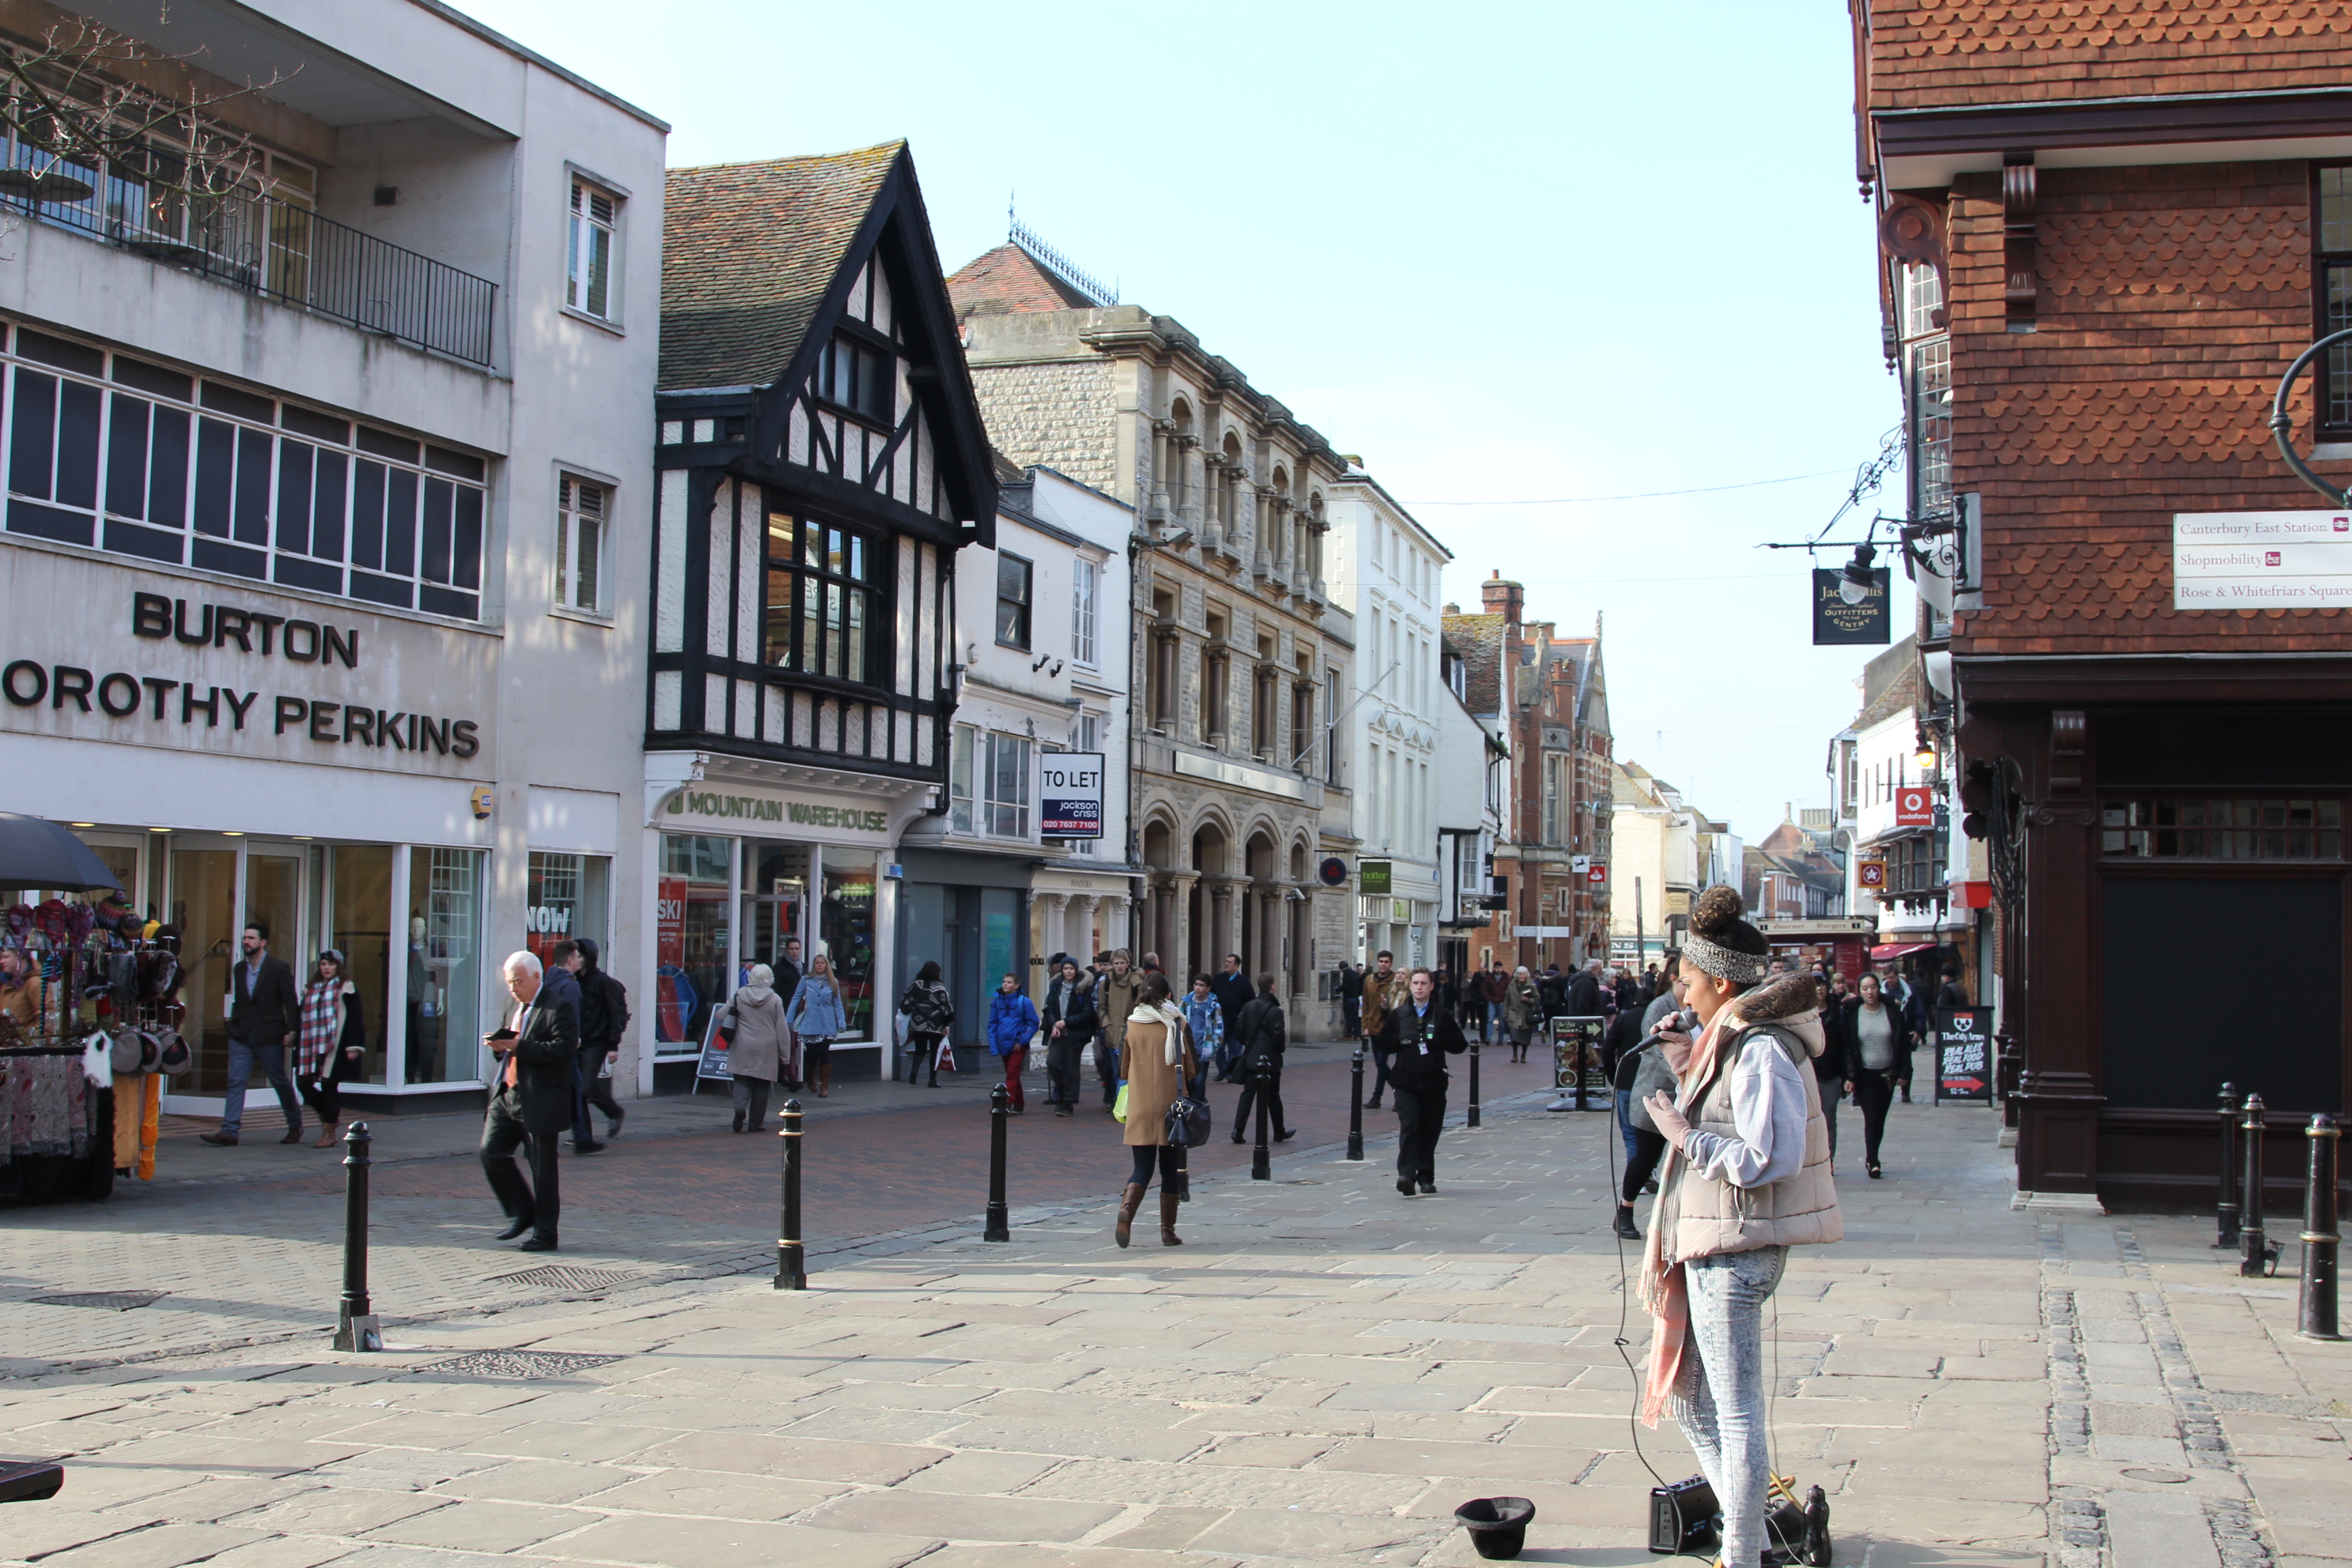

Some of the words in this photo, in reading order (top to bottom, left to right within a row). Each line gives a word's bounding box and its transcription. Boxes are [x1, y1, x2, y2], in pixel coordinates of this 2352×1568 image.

[2180, 523, 2251, 538] Canterbury
[2255, 523, 2280, 533] East
[2284, 522, 2328, 533] Station
[2180, 553, 2263, 569] Shopmobility
[1820, 586, 1840, 601] Jac
[2180, 587, 2212, 598] Rose
[2216, 587, 2226, 597] &
[2232, 585, 2305, 597] Whitefriars
[133, 591, 359, 668] BURTON
[1833, 617, 1870, 628] GENTRY
[2, 658, 259, 730] OROTHY
[276, 695, 480, 758] PERKINS
[1043, 770, 1064, 787] TO
[1070, 771, 1098, 787] LET
[689, 791, 783, 821] MOUNTAIN
[787, 802, 887, 832] WAREHOUSE
[1059, 801, 1098, 811] jackson
[1071, 879, 1092, 887] PANDORA
[1362, 871, 1389, 880] hotter
[658, 899, 681, 919] SKI
[526, 906, 570, 932] NOW
[1941, 1032, 1955, 1041] The
[1955, 1032, 1967, 1043] City
[1968, 1032, 1985, 1041] Arms
[1944, 1046, 1963, 1057] REAL
[1964, 1042, 1984, 1054] ALES
[1942, 1056, 1962, 1066] REAL
[1963, 1051, 1984, 1063] FOOD
[1944, 1064, 1964, 1075] REAL
[1965, 1060, 1984, 1071] PUB
